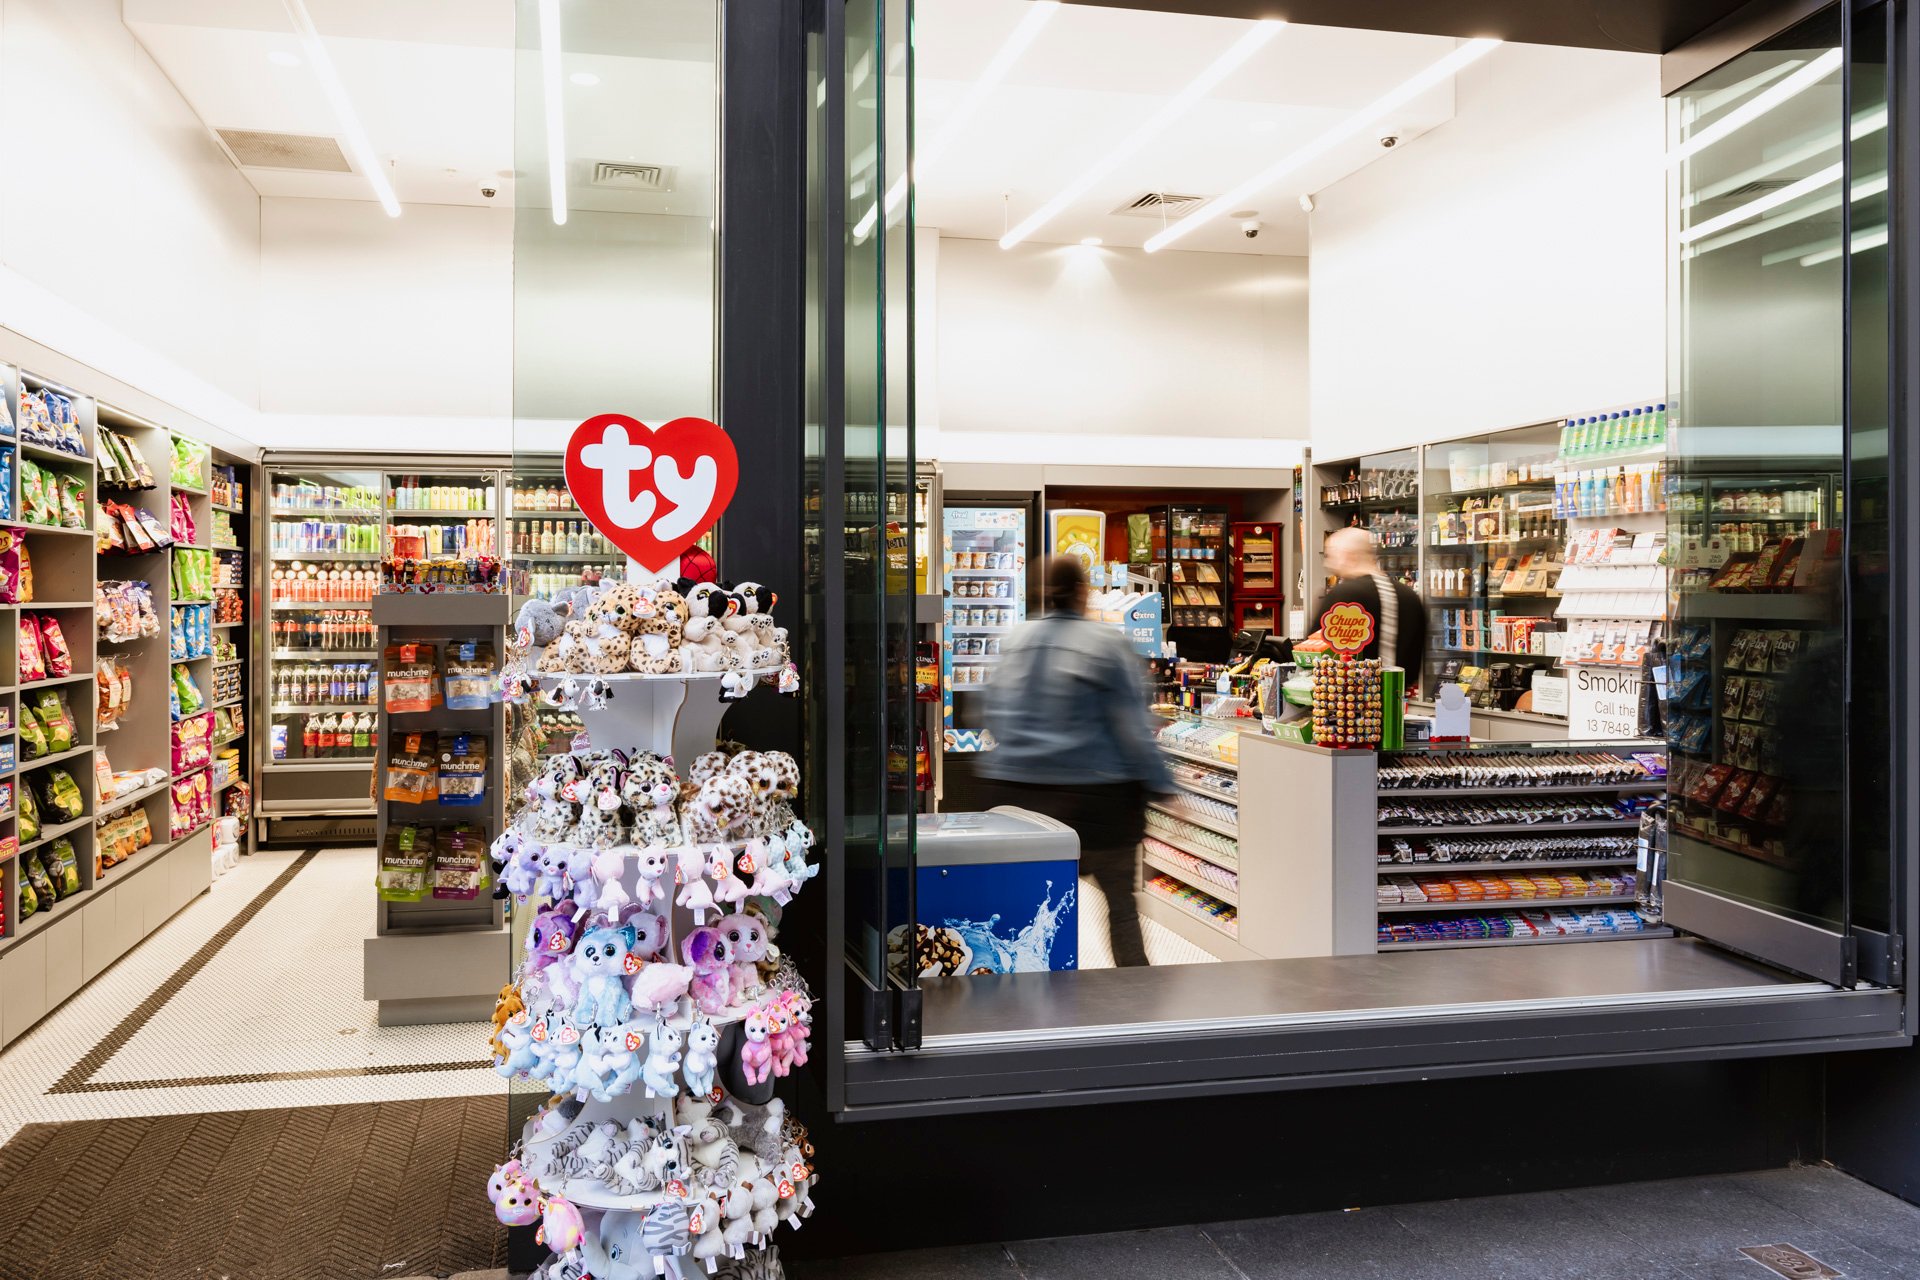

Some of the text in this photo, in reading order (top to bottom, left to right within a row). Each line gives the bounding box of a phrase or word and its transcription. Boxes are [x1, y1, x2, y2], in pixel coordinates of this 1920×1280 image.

[580, 423, 718, 542] ty
[1131, 610, 1155, 621] extra
[1330, 615, 1366, 628] Chupa
[1133, 628, 1154, 637] GET
[1328, 626, 1364, 644] Chups
[387, 667, 429, 677] munchme
[447, 665, 487, 674] munchme
[1594, 701, 1636, 717] Call the
[1587, 719, 1598, 732] 13
[1601, 720, 1631, 736] 7848
[440, 760, 480, 770] munchme
[384, 855, 424, 865] munchme
[437, 854, 476, 864] munchme
